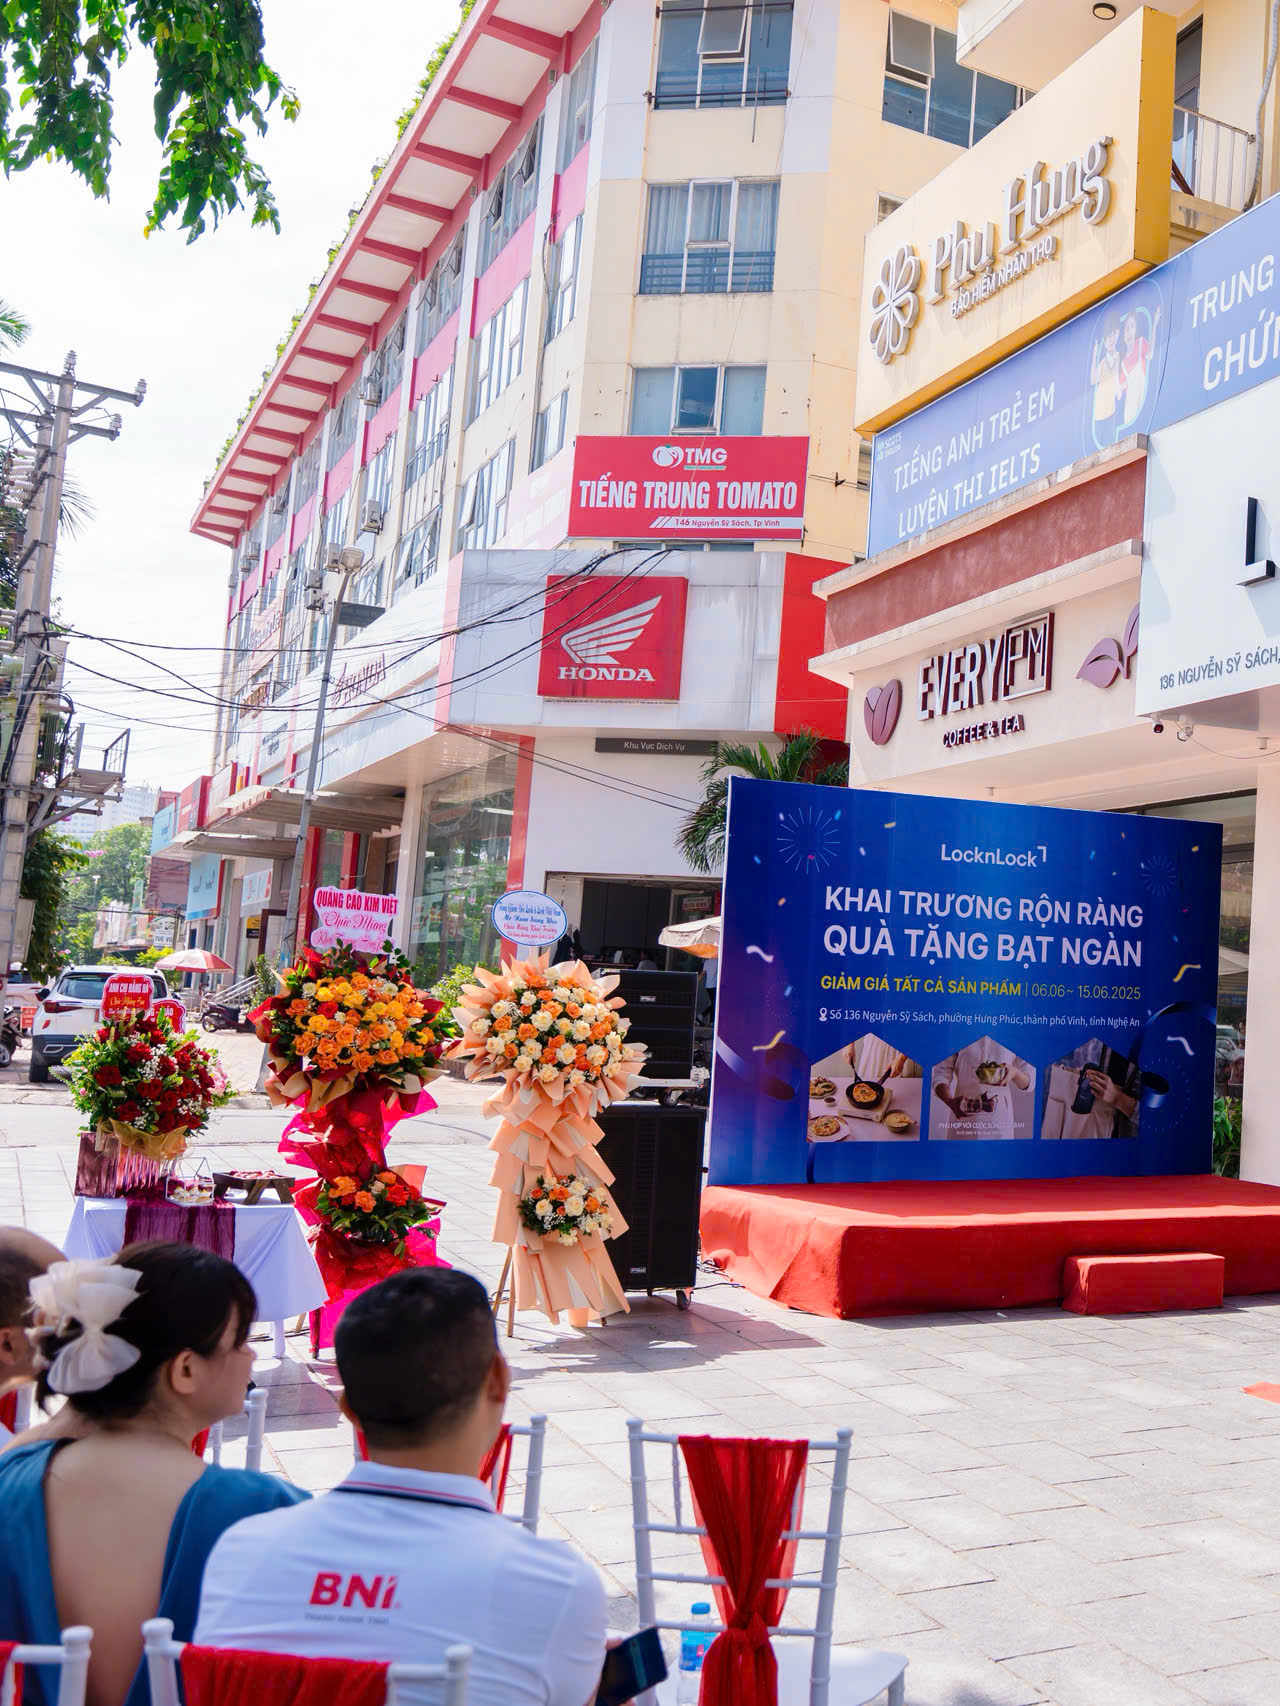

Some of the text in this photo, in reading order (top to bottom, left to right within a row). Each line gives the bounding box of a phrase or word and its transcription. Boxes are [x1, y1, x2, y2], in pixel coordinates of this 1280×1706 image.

[1189, 255, 1275, 329] TRUNG
[894, 382, 1055, 493] TIẾNG ANH TRẺ EM
[684, 447, 728, 465] TMG
[579, 472, 798, 510] TIẾNG TRUNG TOMATO
[898, 443, 1040, 539] LUYỆN THI IELTS
[675, 518, 781, 529] 146 Nguyễn Sỹ Sách, Tp Vinh
[558, 667, 656, 682] HONDA
[1160, 673, 1175, 691] 136
[1178, 656, 1223, 686] NGUYỄN
[1226, 653, 1241, 674] SỸ
[1245, 646, 1280, 669] SÁCH,
[624, 741, 639, 750] Khu
[656, 742, 673, 752] Dịch
[675, 743, 685, 753] Vụ
[942, 714, 1025, 748] COFFEE & TEA
[940, 844, 1037, 867] LocknLock
[316, 887, 398, 917] QUẢNG CÁO KIM VIỆT
[825, 886, 1144, 929] KHAI TRƯƠNG RỘN RÀNG
[823, 919, 1142, 969] QUÀ TẶNG BẠT NGÀN
[820, 972, 861, 990] GIẢM
[864, 974, 890, 991] GIÁ
[894, 974, 921, 992] TẤT
[923, 976, 944, 993] CẢ
[948, 976, 977, 994] SẢN
[980, 978, 1021, 996] PHẨM
[1077, 985, 1141, 1000] 15.06.2025
[829, 1008, 842, 1020] Số
[844, 1009, 861, 1020] 136
[862, 1009, 898, 1023] Nguyễn
[900, 1010, 911, 1023] Sỹ
[912, 1010, 937, 1024] Sách,
[938, 1011, 973, 1025] phường
[975, 1014, 997, 1025] Hưng
[1049, 1015, 1066, 1027] phố
[1068, 1016, 1088, 1027] Vinh,
[1090, 1015, 1106, 1027] tỉnh
[1107, 1017, 1129, 1029] Nghệ
[1129, 1018, 1140, 1027] An
